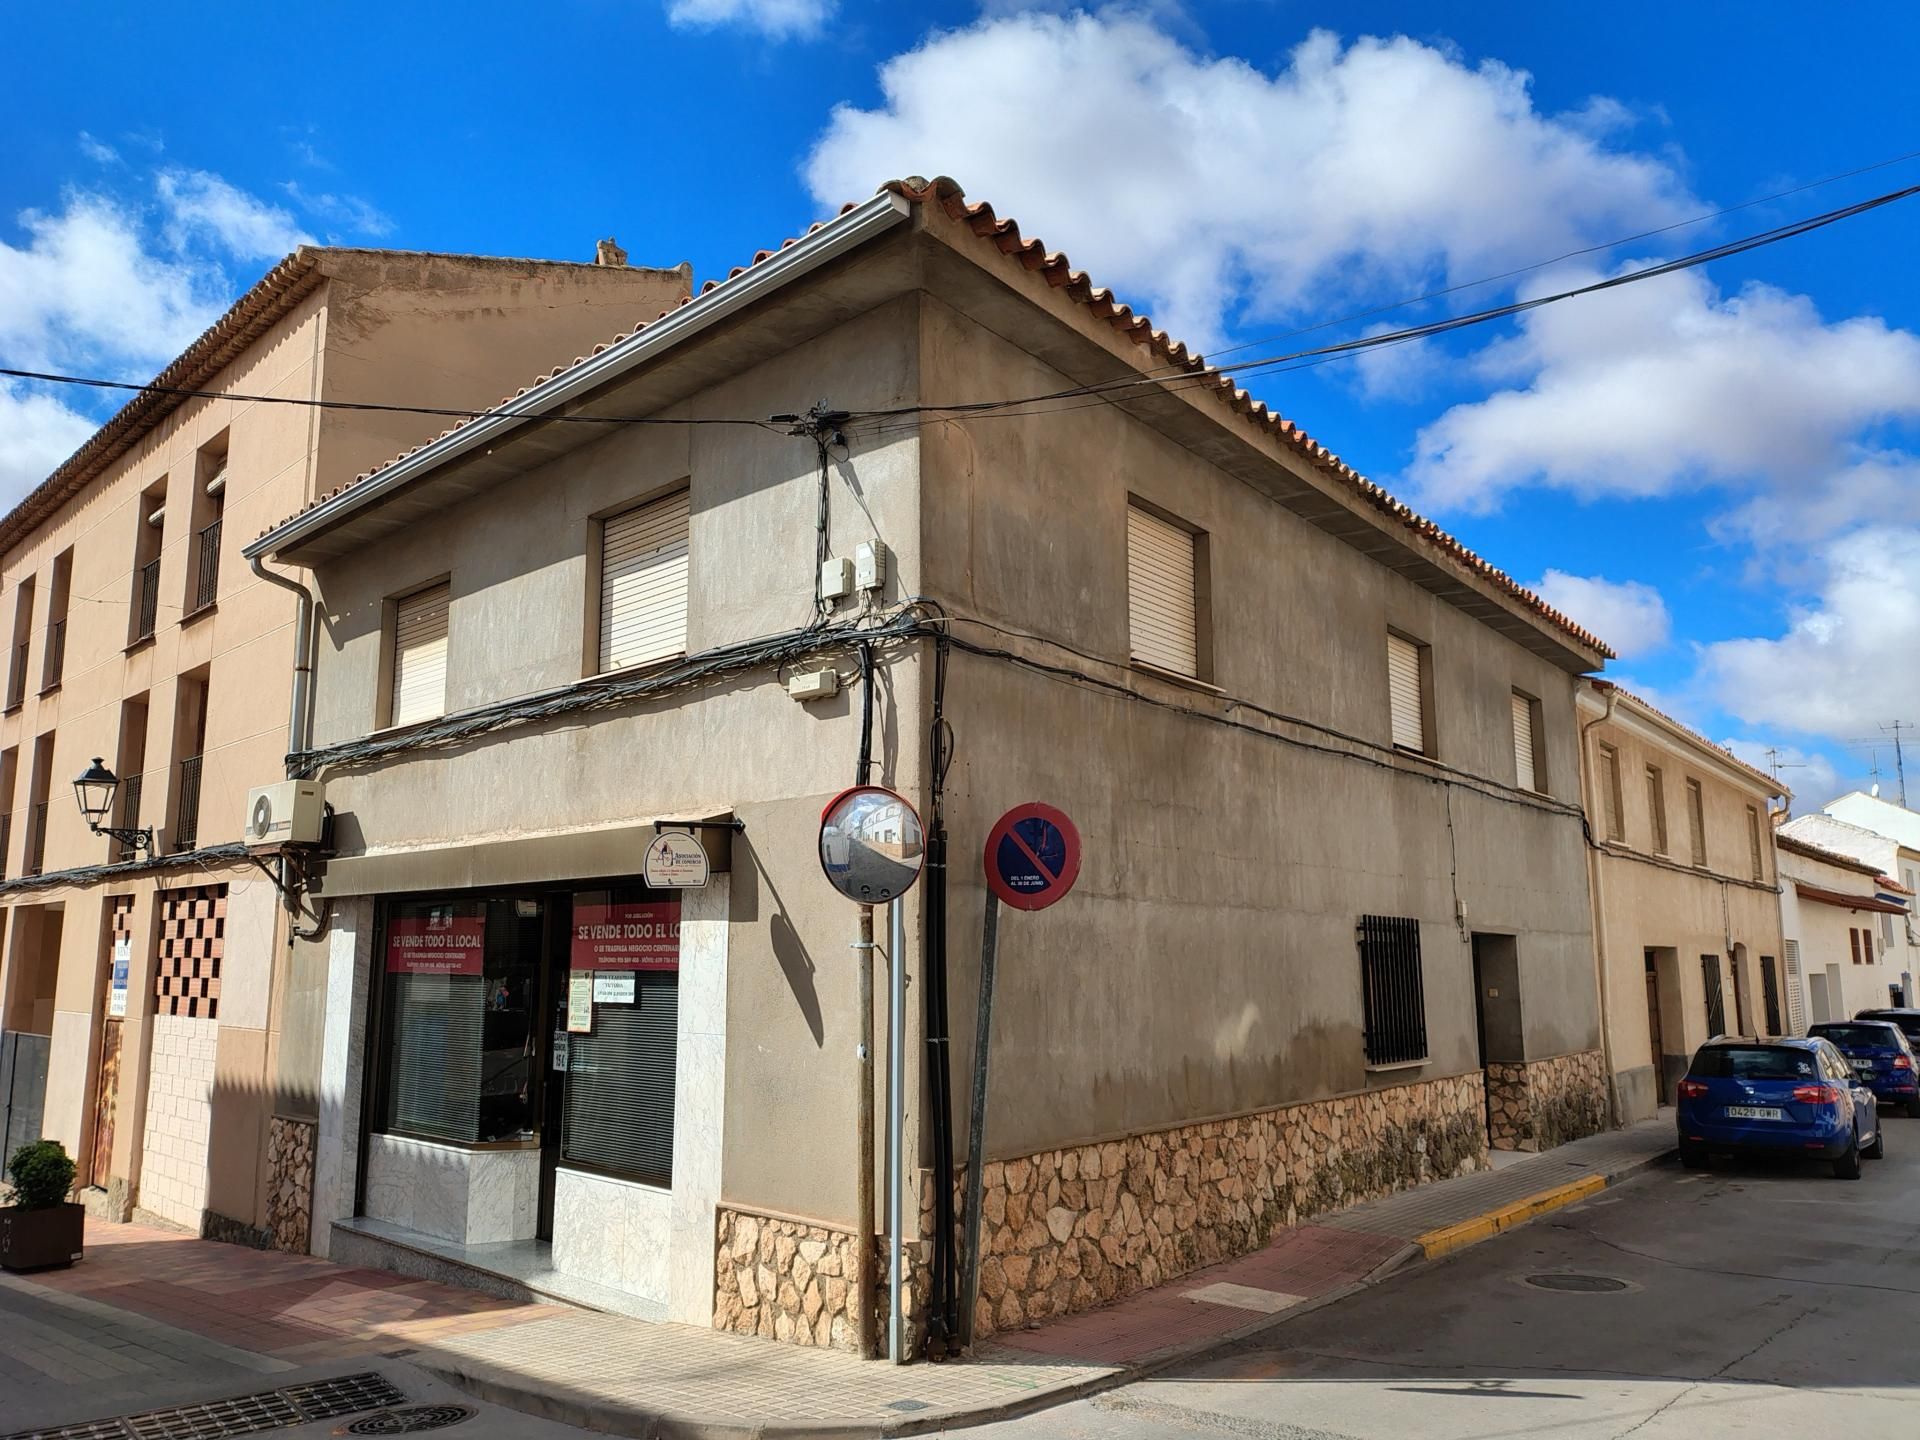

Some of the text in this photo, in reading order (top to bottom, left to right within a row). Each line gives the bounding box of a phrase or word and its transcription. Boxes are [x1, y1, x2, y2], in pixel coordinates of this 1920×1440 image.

[578, 925, 589, 940] SE
[590, 924, 622, 939] VENDE
[623, 924, 653, 939] TODO
[655, 923, 667, 938] EL
[393, 935, 481, 948] SE VENDE TODO EL LOCAL
[628, 944, 652, 952] NEGOCIO
[1731, 1107, 1756, 1117] 0429
